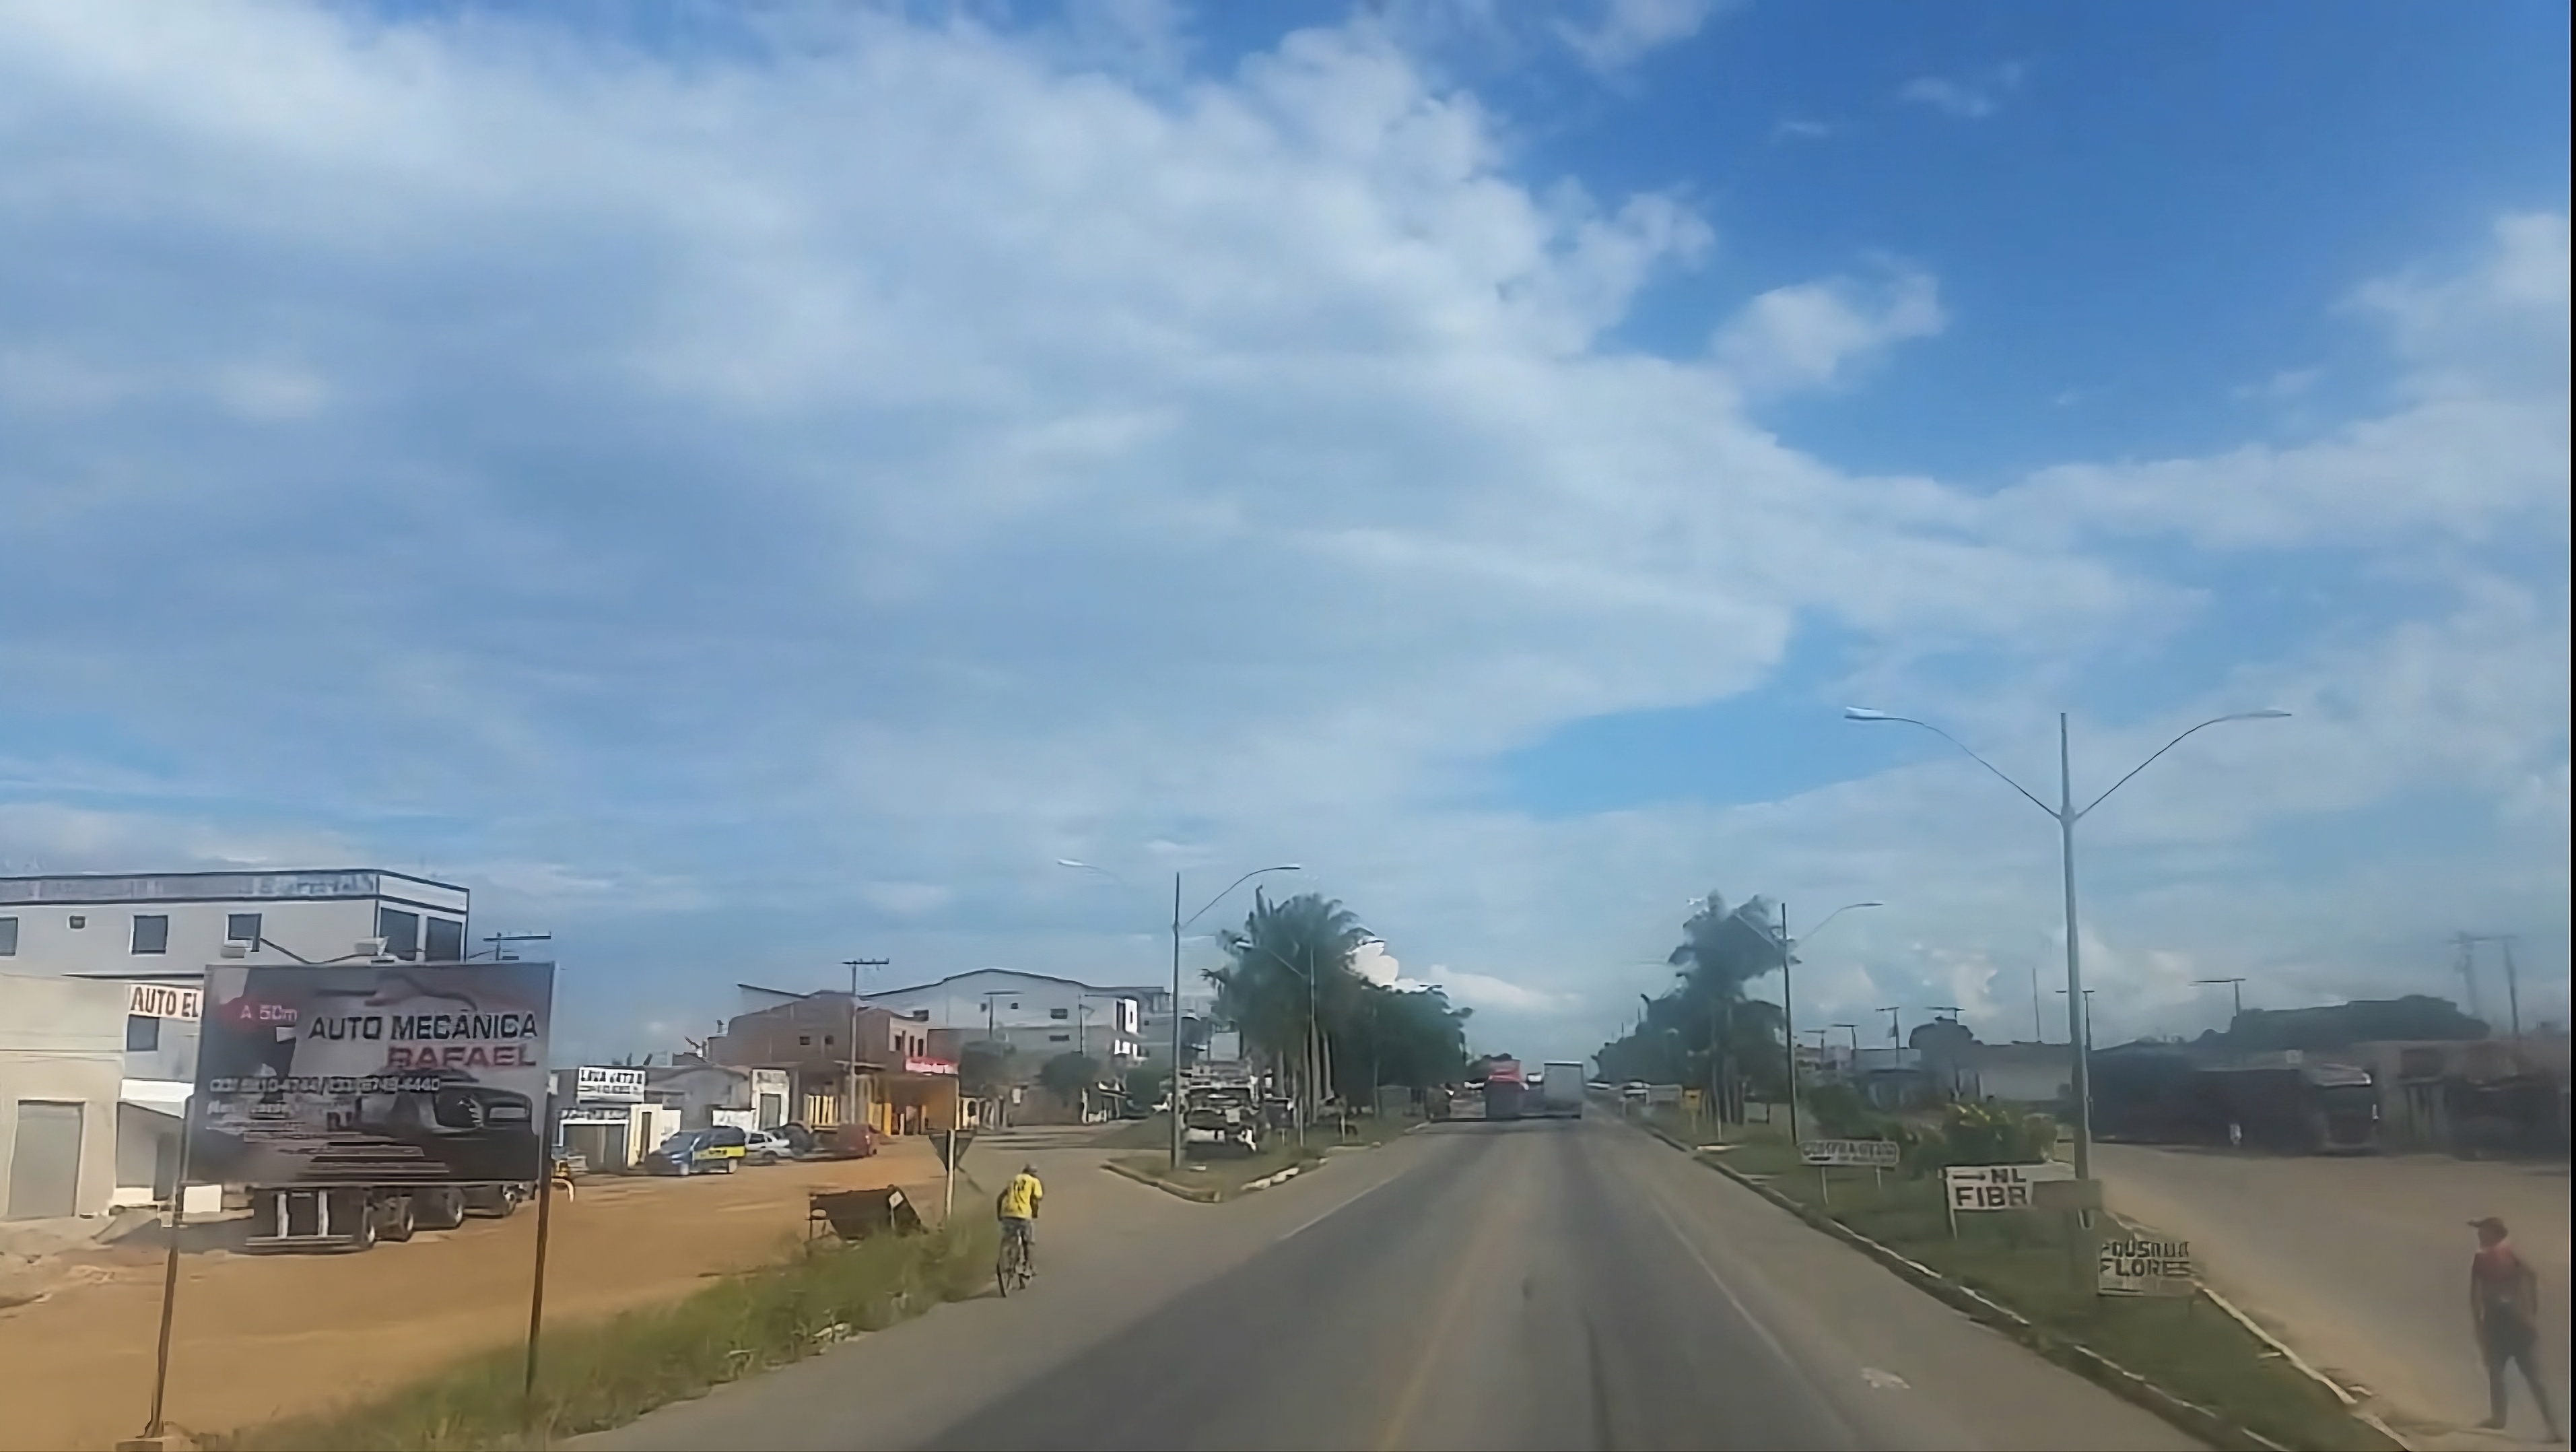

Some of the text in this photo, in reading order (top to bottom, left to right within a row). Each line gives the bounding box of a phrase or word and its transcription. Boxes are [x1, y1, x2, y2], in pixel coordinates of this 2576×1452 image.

[131, 987, 176, 1015] AUTO
[308, 1010, 538, 1040] AUTO MECÂNICA
[388, 1047, 536, 1067] RAFAEL
